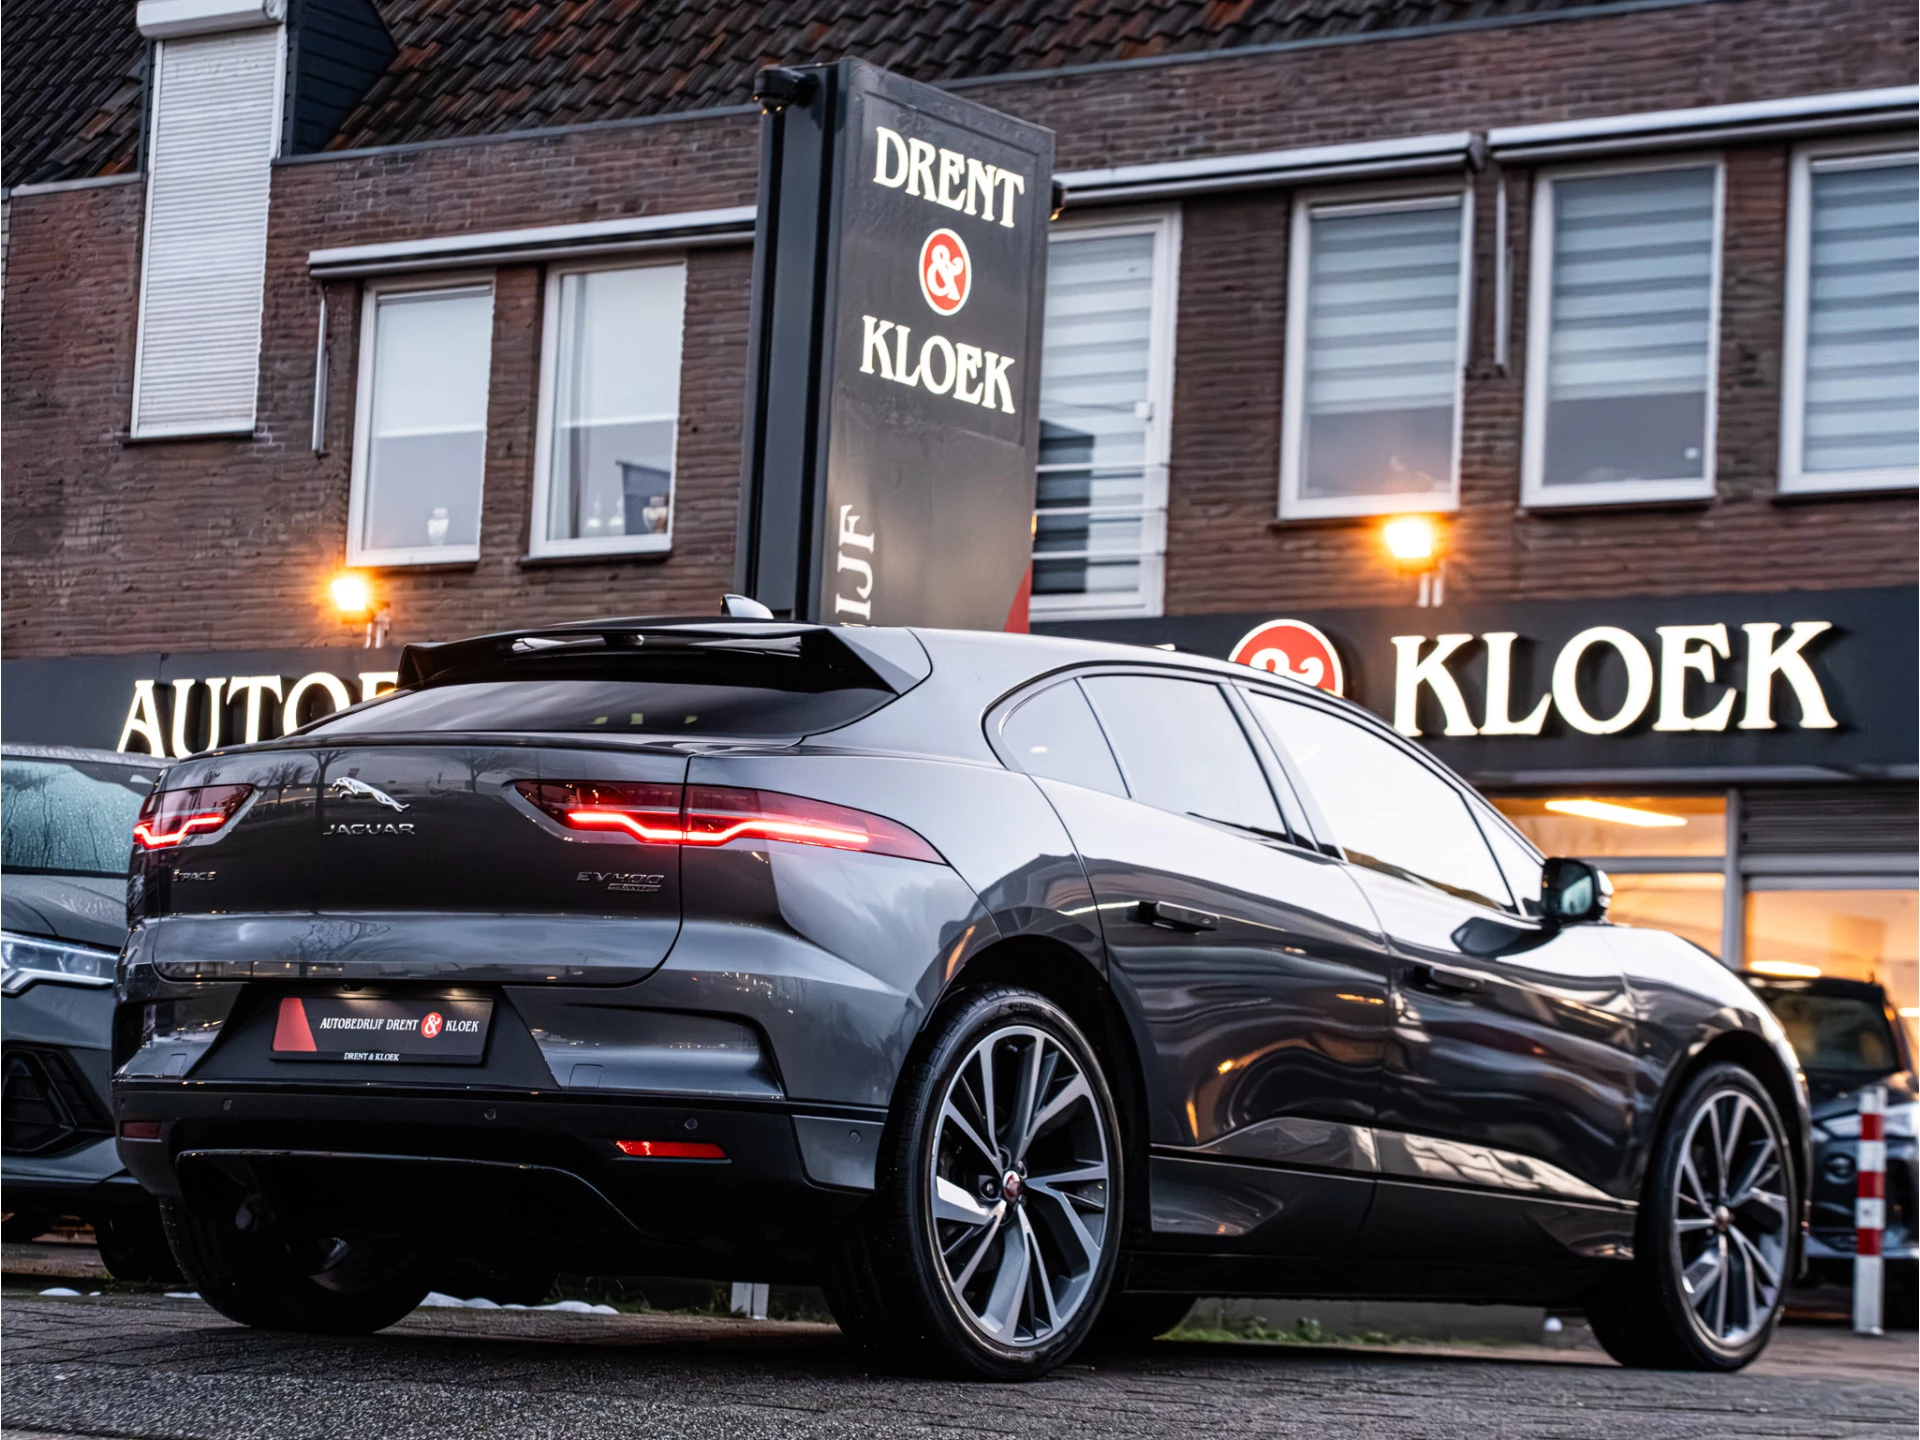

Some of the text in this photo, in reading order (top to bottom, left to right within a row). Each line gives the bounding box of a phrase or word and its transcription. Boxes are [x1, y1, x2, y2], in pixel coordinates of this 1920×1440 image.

[872, 126, 1025, 228] DRENT
[926, 243, 964, 301] &
[859, 314, 1016, 415] KLOEK
[834, 503, 876, 627] IJF
[1390, 620, 1838, 738] KLOEK
[323, 822, 416, 836] JAGUAR
[320, 1015, 479, 1035] AUTOBEDRIJF DRENT & KLOEK
[344, 1052, 368, 1060] DRENT
[375, 1053, 399, 1061] KLOEK
